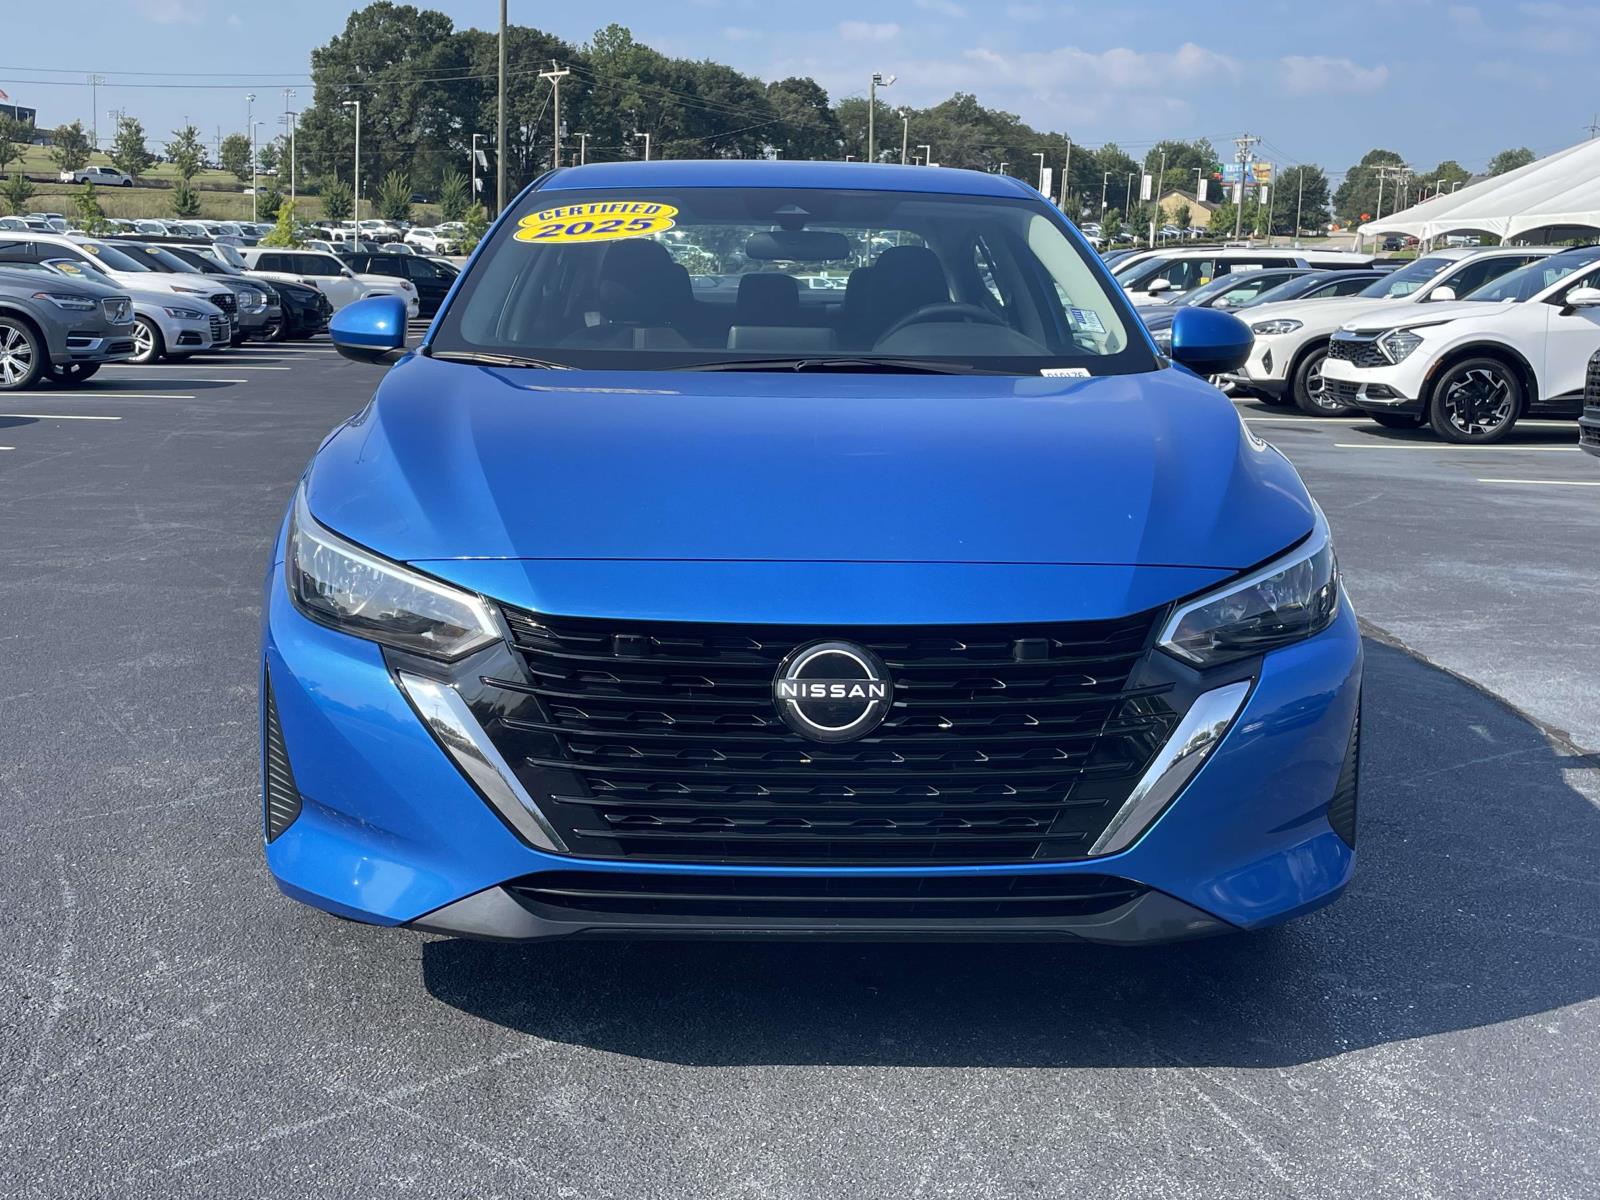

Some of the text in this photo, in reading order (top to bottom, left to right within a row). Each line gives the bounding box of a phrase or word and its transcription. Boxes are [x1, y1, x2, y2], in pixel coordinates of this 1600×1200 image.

[538, 203, 662, 221] CERTIFIED
[531, 217, 656, 239] 2025
[781, 683, 885, 698] NISSAN
